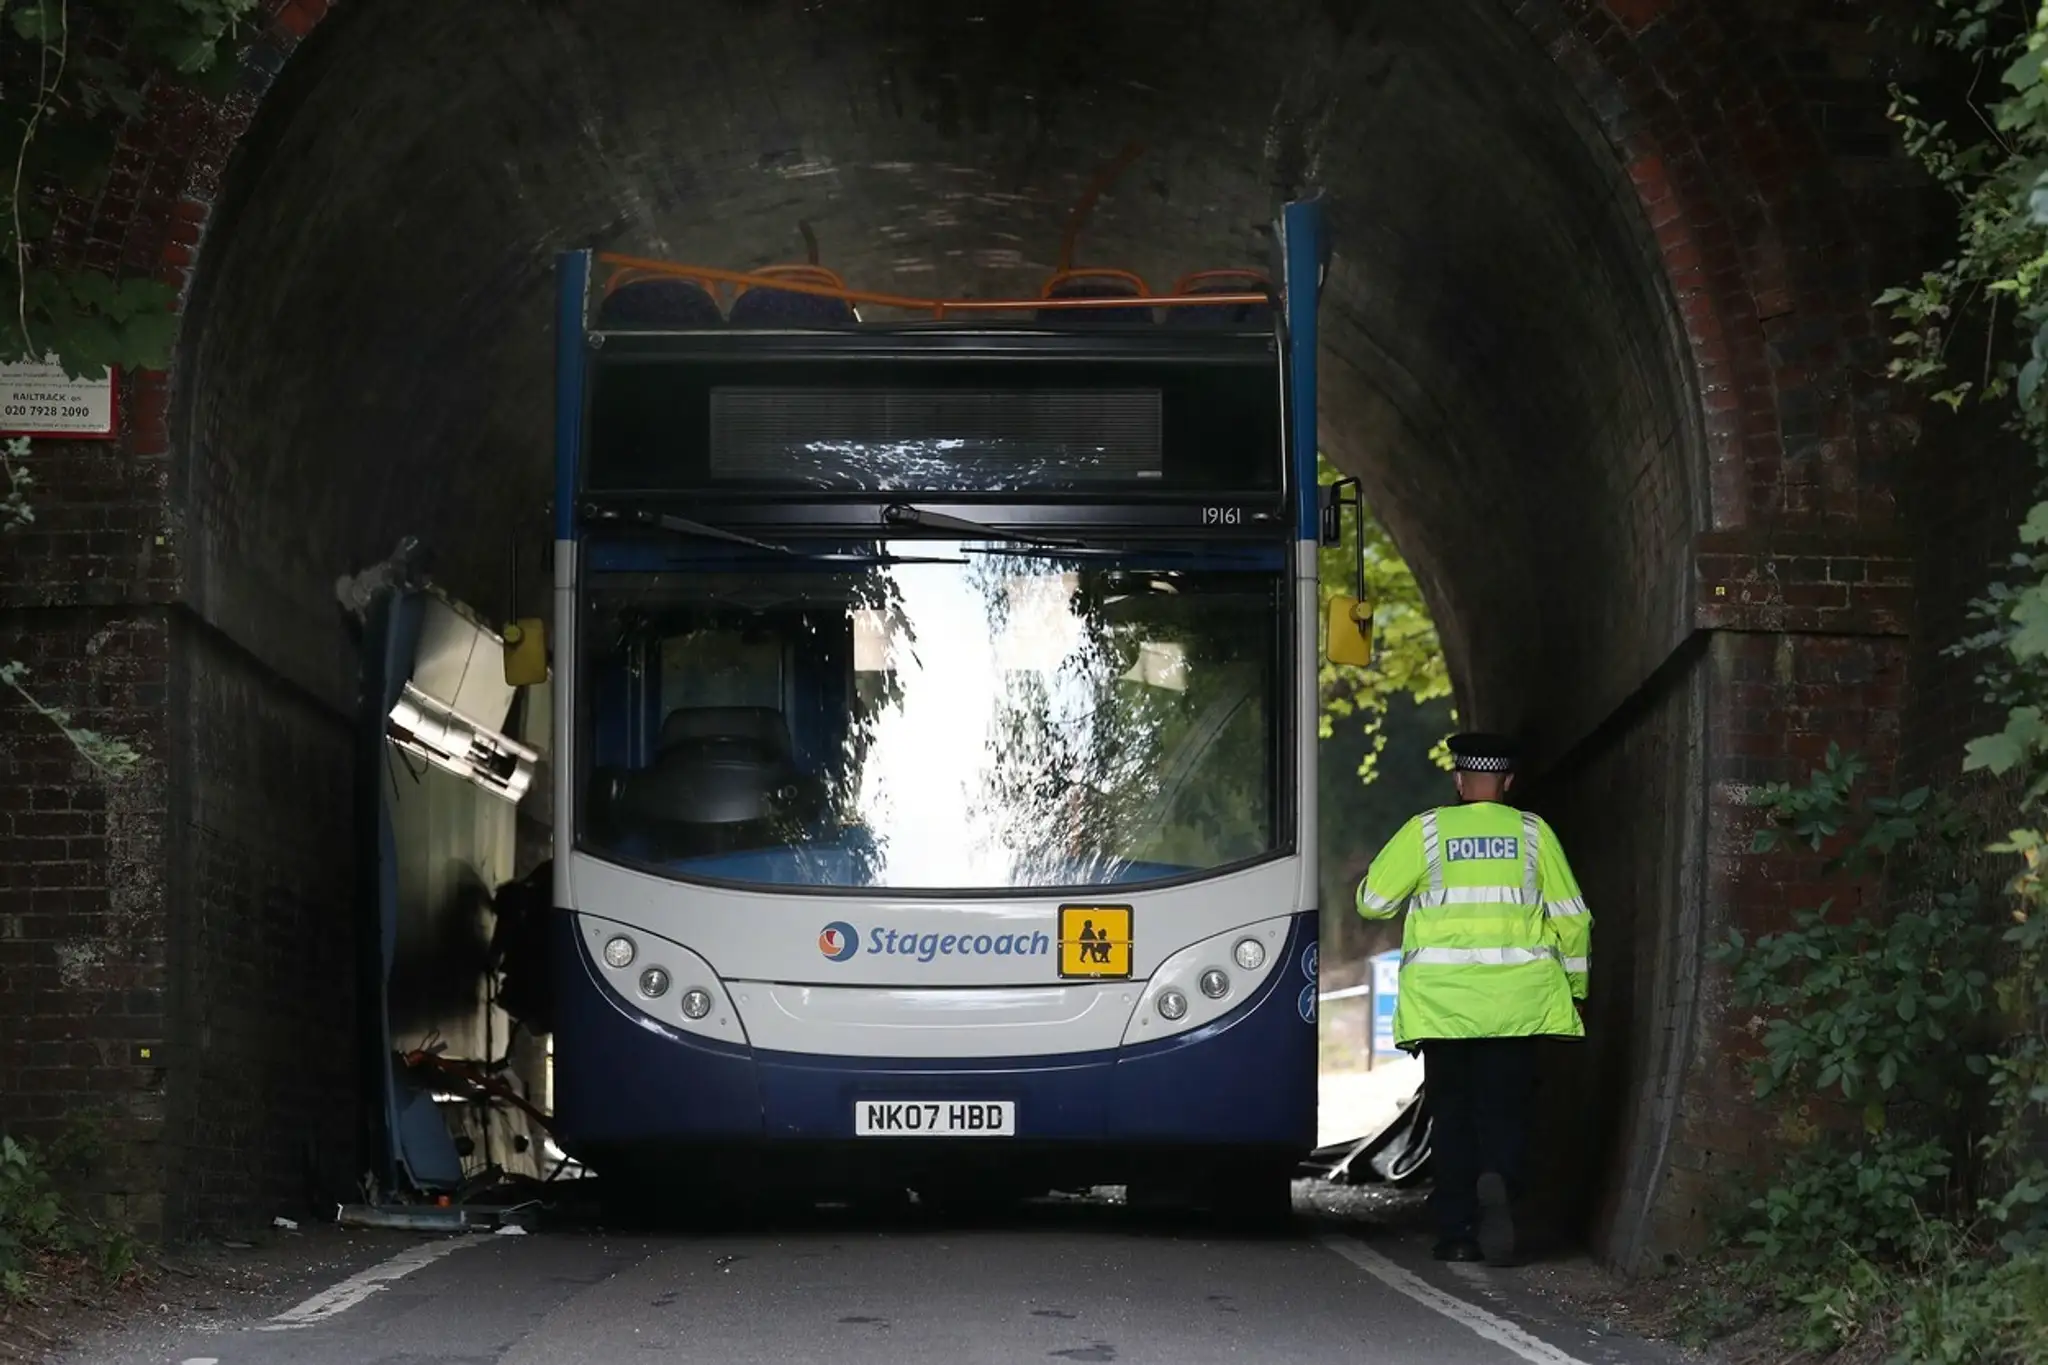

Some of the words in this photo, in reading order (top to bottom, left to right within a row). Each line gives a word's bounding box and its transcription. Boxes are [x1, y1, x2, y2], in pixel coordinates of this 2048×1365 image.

[12, 393, 67, 401] RAILTRACK
[4, 405, 26, 416] 020
[30, 406, 57, 417] 7928
[61, 406, 89, 418] 2090
[1202, 507, 1241, 524] 19161
[1448, 838, 1516, 860] POLICE
[867, 926, 1049, 963] Stagecoach
[868, 1104, 940, 1130] NK07
[949, 1104, 1003, 1130] HBD
